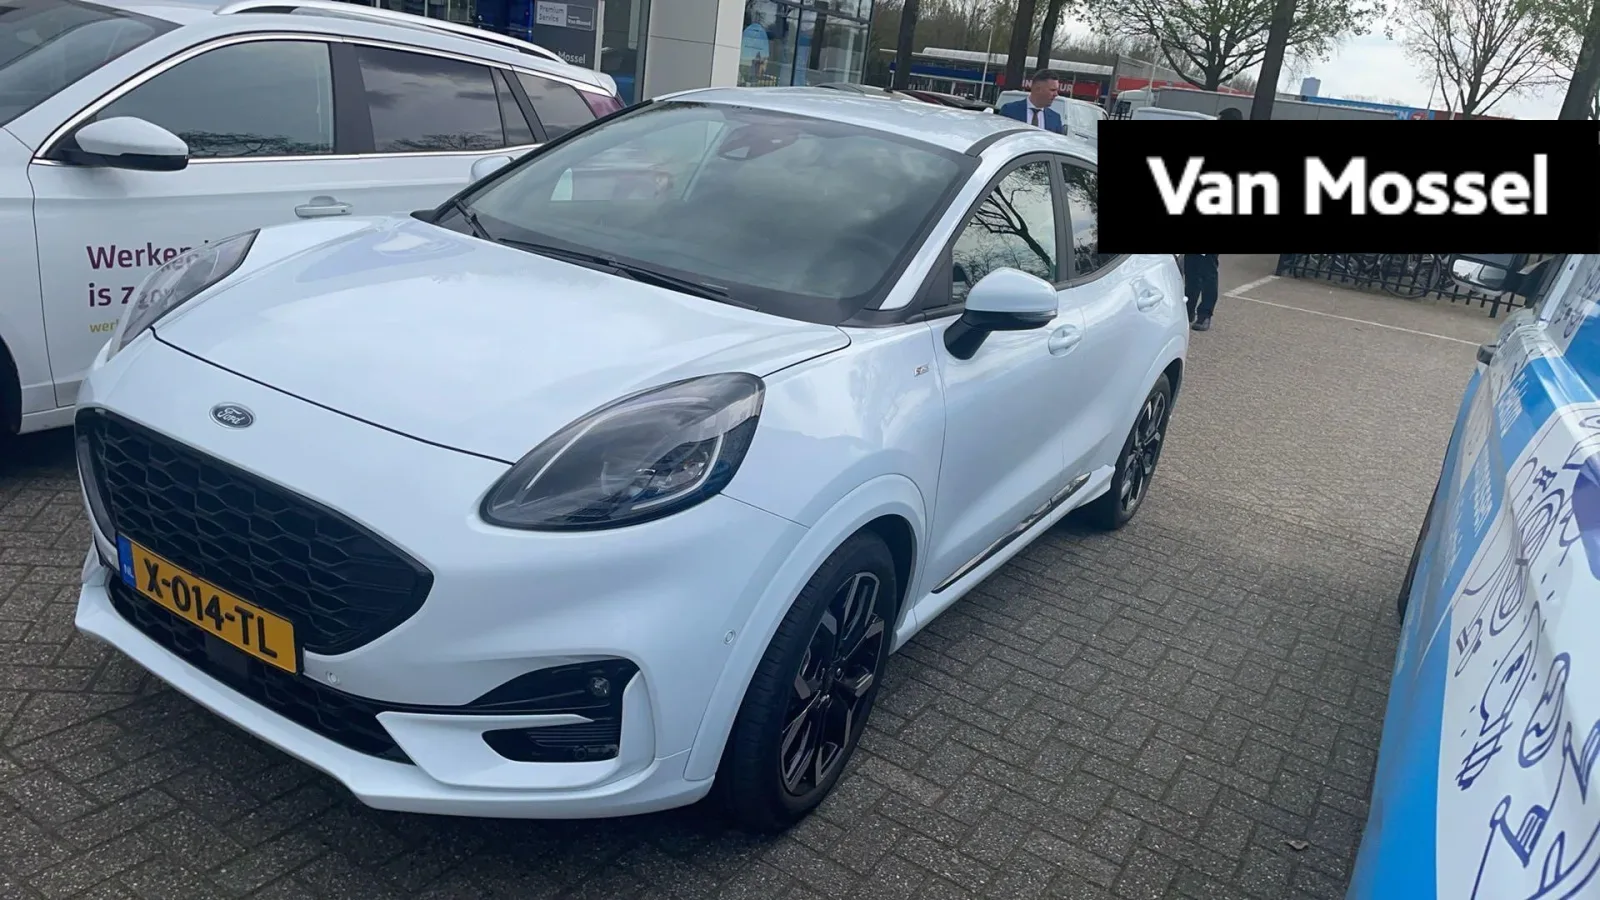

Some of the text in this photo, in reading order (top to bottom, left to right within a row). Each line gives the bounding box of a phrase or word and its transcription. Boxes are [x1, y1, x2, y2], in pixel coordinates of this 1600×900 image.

[539, 4, 564, 14] Premium
[538, 13, 560, 22] Service
[558, 50, 586, 64] Mossel
[88, 282, 112, 307] is
[216, 407, 244, 426] Ford
[144, 557, 278, 659] X-014-TL
